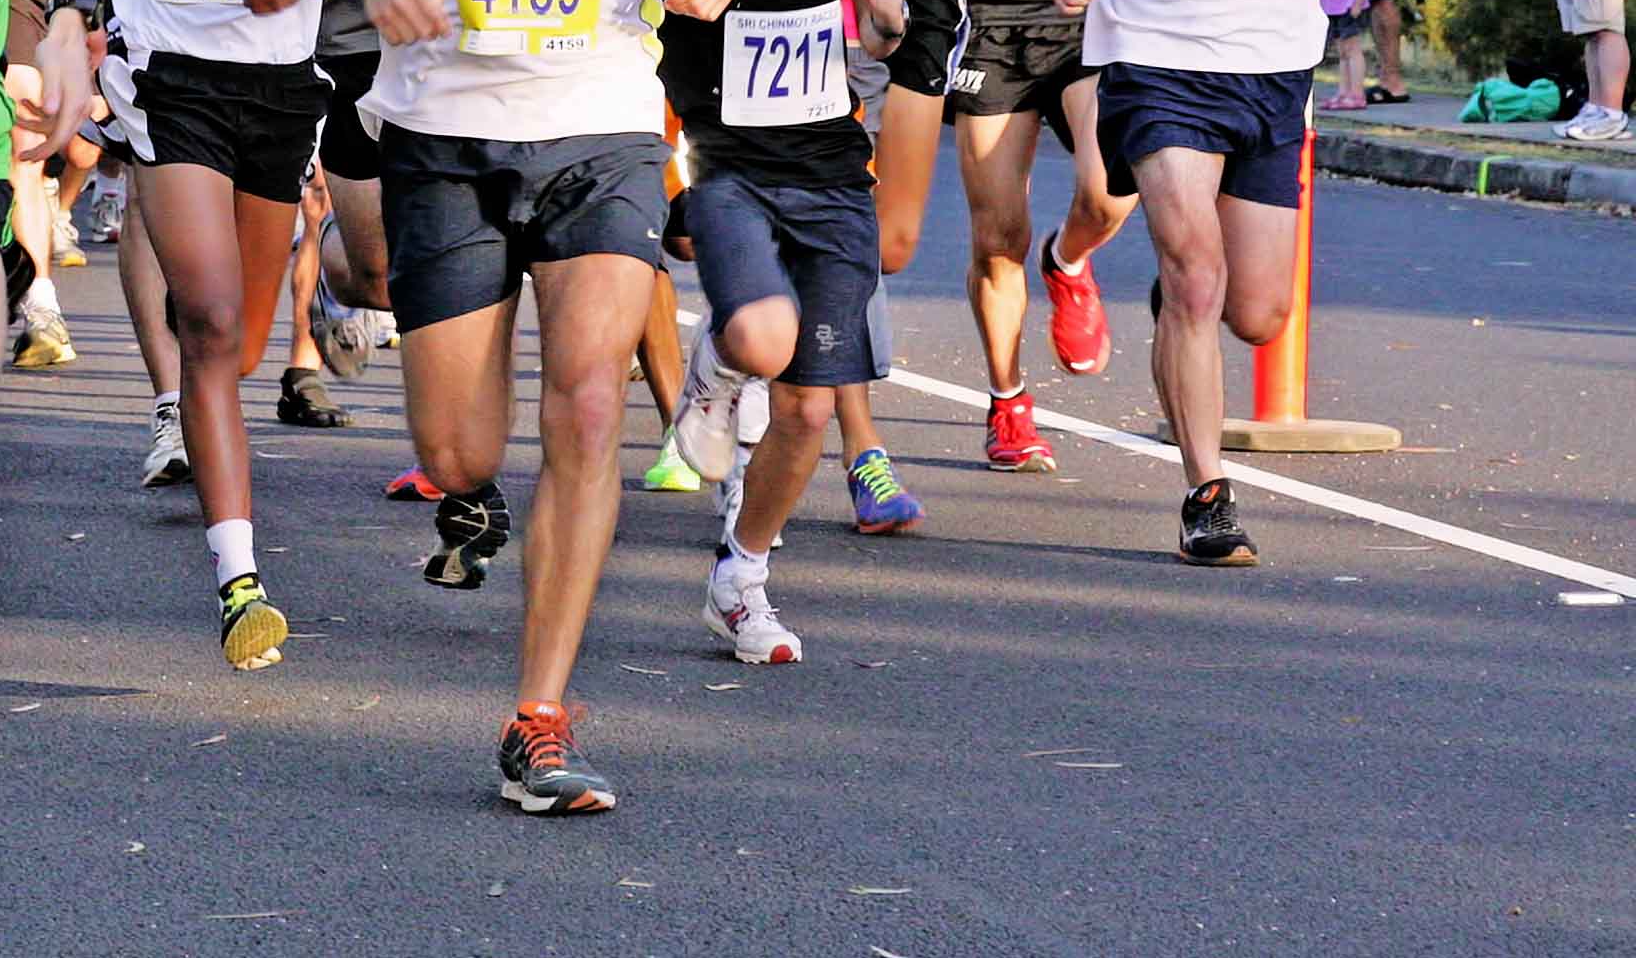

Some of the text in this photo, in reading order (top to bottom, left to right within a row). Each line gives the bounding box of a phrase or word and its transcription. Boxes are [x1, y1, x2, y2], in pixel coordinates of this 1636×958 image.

[737, 18, 756, 29] SRI
[759, 17, 808, 30] CHINMOY
[546, 39, 585, 50] 4159
[744, 28, 833, 98] 7217
[805, 102, 836, 118] 7217
